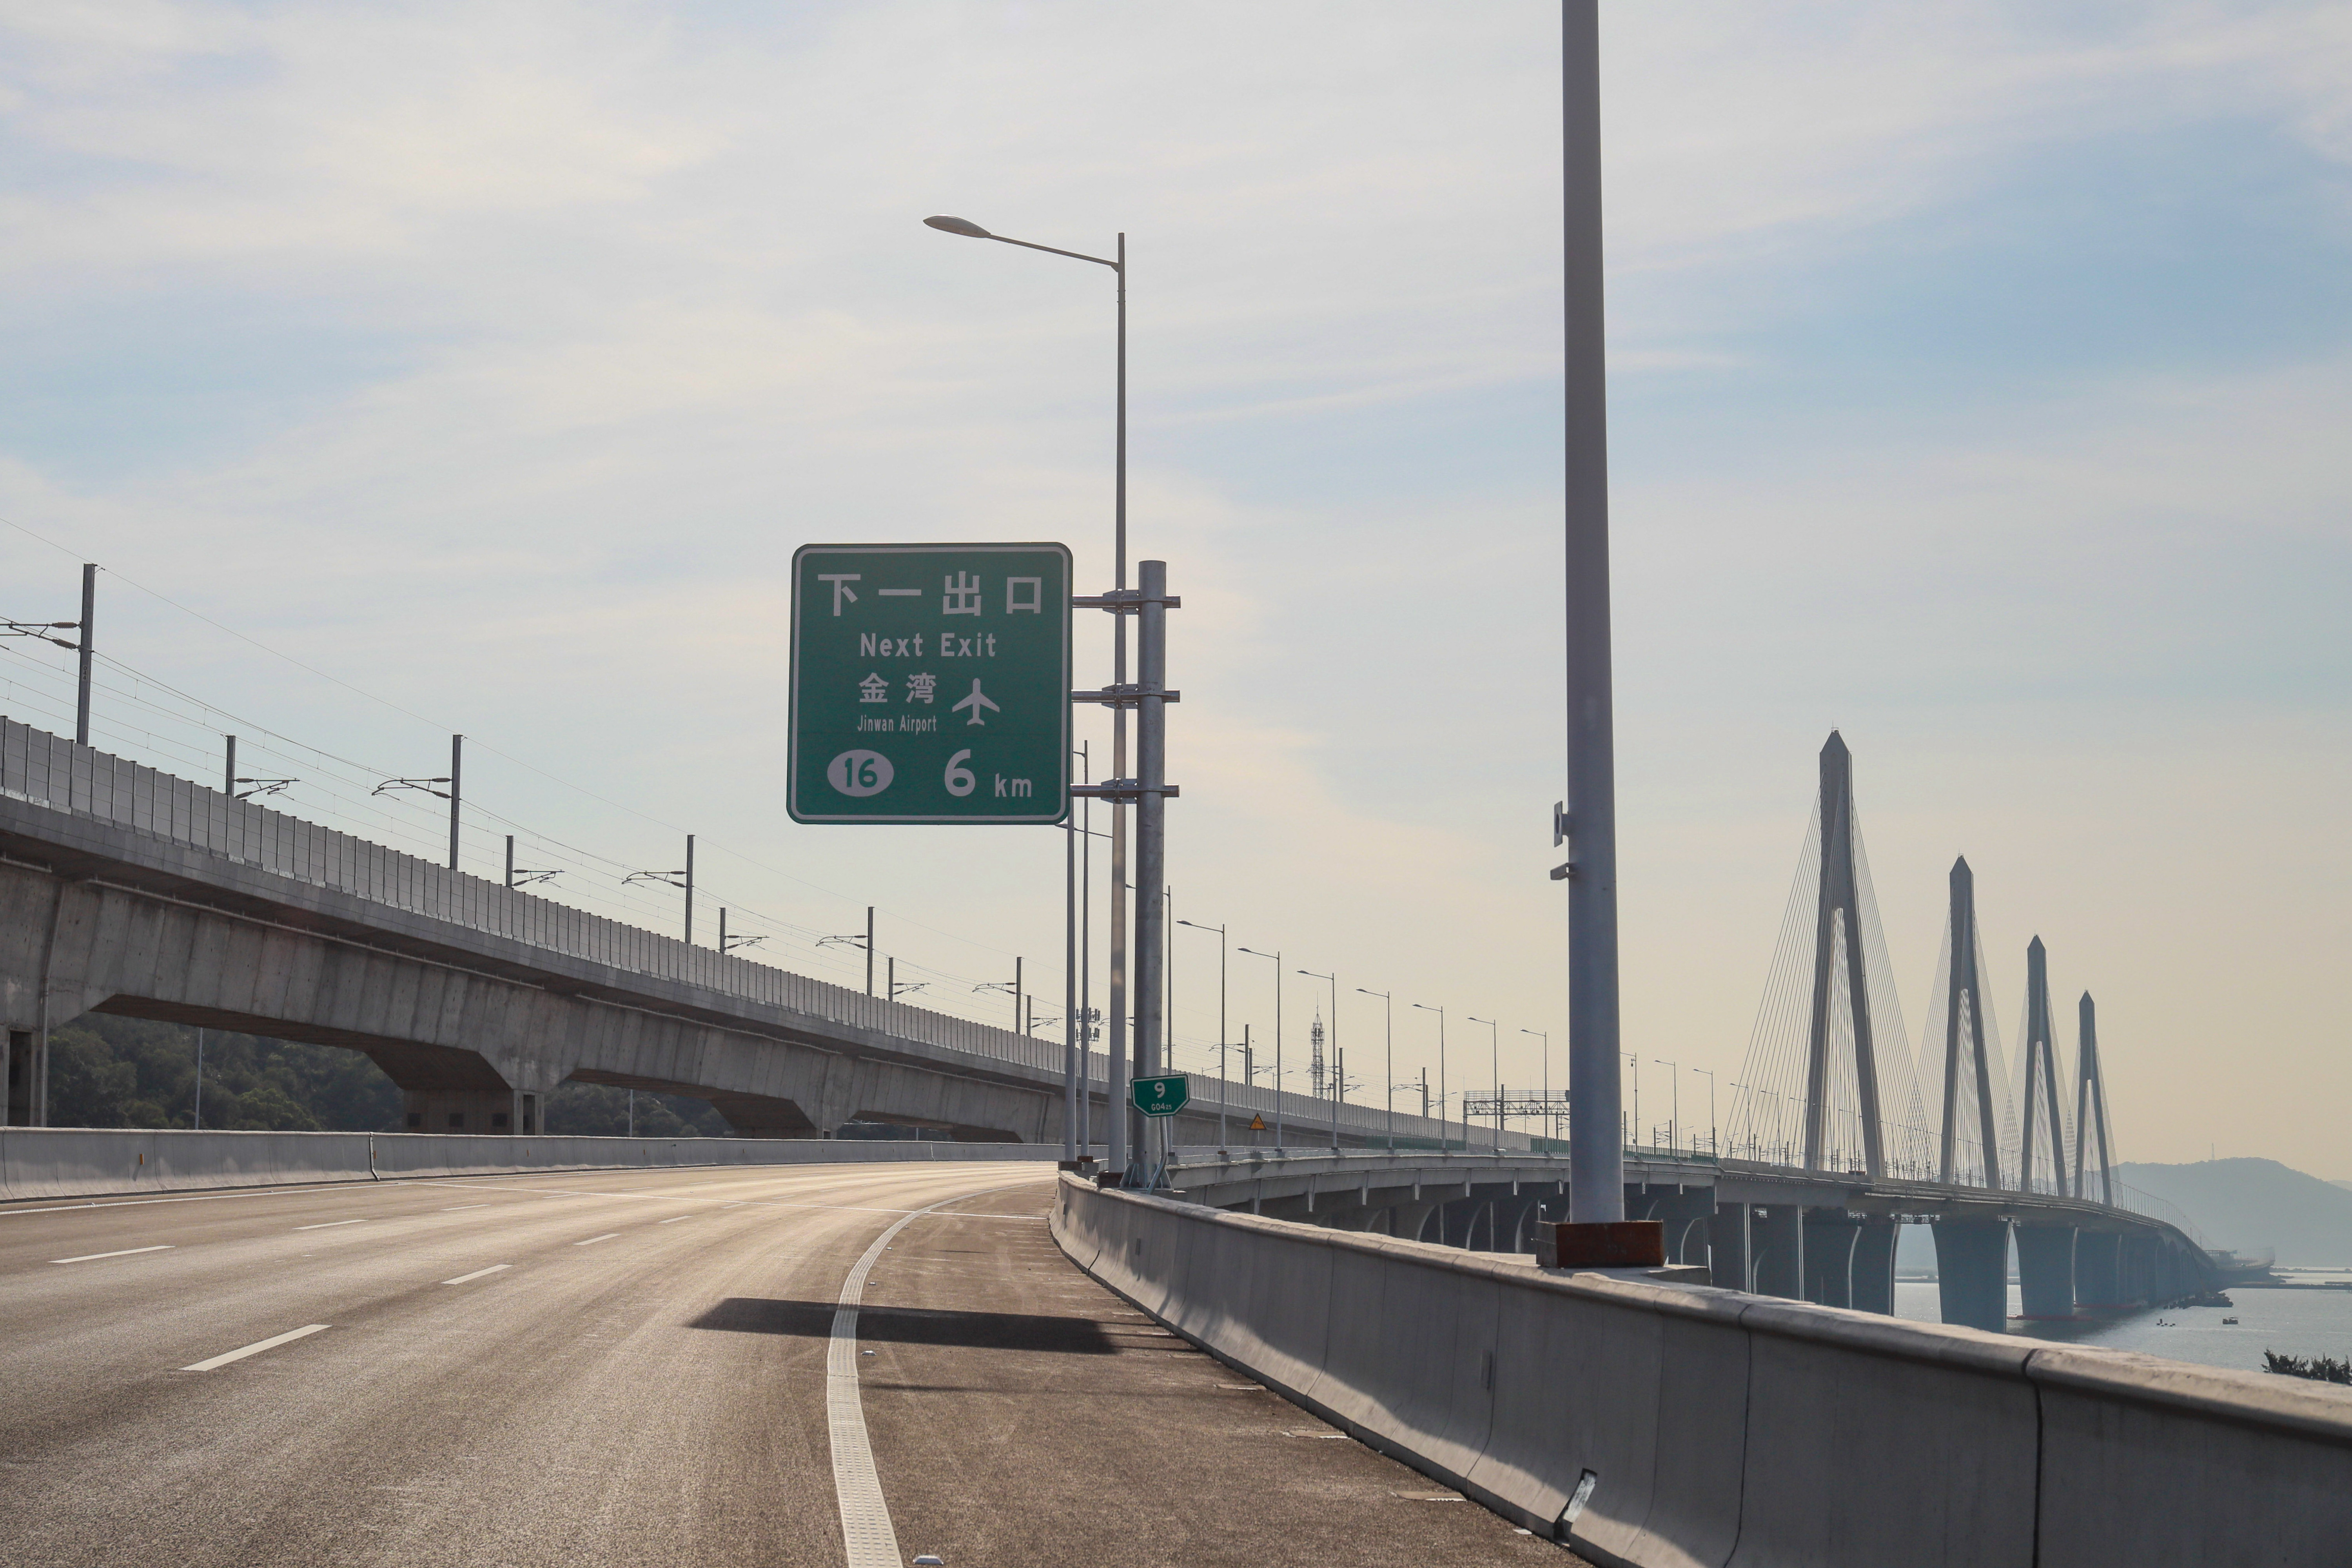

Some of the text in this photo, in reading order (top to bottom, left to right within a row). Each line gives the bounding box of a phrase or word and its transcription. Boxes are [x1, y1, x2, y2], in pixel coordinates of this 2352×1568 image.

[818, 571, 1042, 617] 下一出口
[860, 632, 996, 657] Next Exit
[858, 672, 936, 704] 金湾
[857, 714, 936, 735] Jinwan Airport
[844, 758, 878, 788] 16
[944, 749, 1032, 797] 6 km
[1154, 1082, 1165, 1098] 9
[1151, 1102, 1172, 1111] G0425
